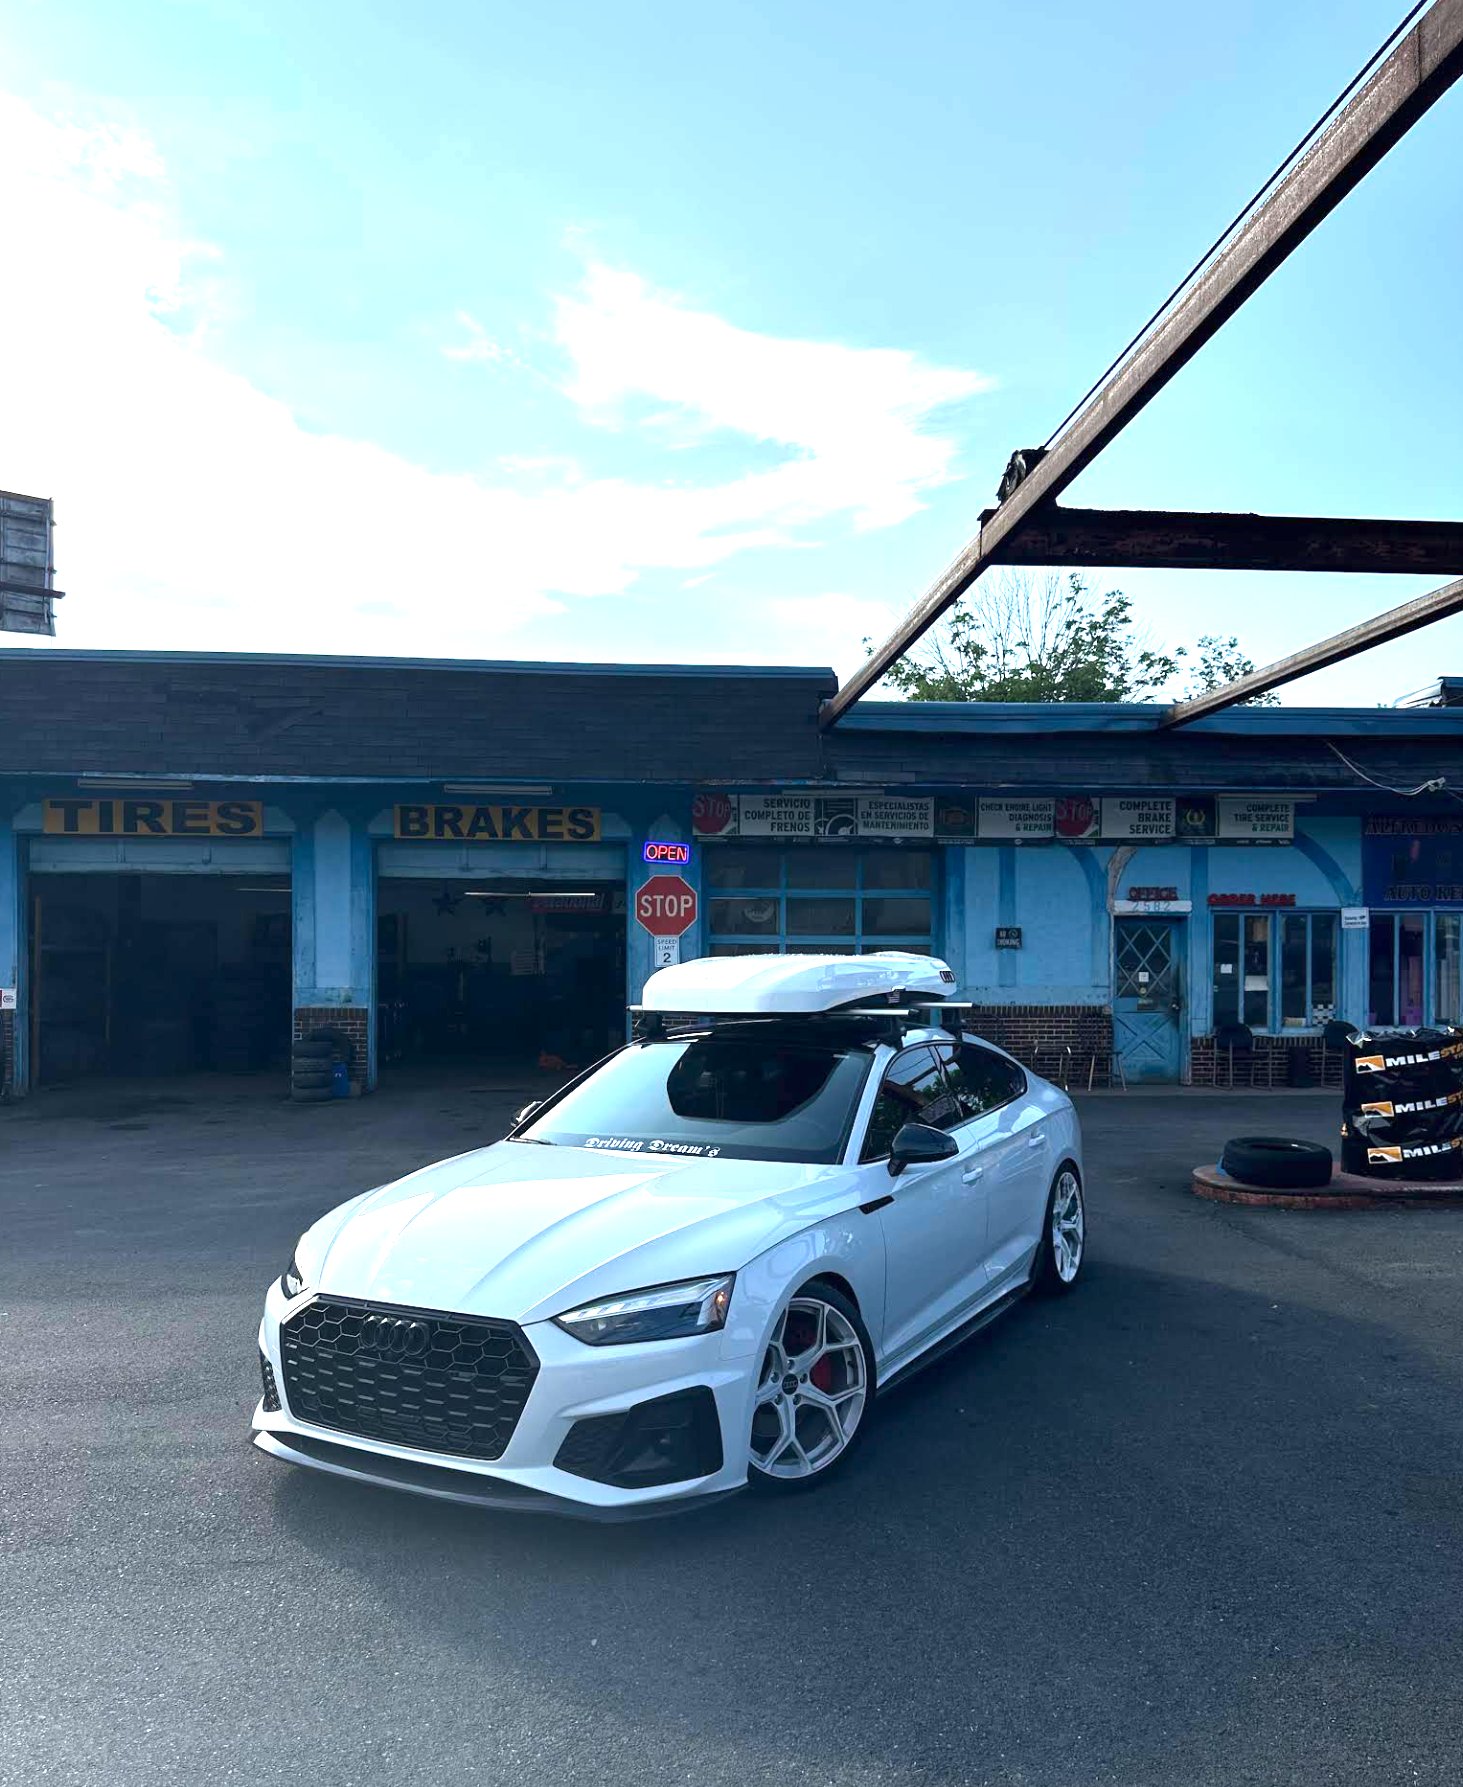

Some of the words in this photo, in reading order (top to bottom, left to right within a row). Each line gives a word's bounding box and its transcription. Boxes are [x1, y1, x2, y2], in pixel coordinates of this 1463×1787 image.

[693, 797, 731, 817] STOP
[763, 798, 811, 808] SERVICIO
[868, 801, 930, 811] ESPECIALISTAS
[980, 803, 1003, 812] CHECK
[1005, 803, 1030, 812] ENGINE
[1032, 803, 1052, 812] LIGHT
[1119, 801, 1172, 811] COMPLETE
[1246, 803, 1290, 813] COMPLETE
[50, 801, 257, 834] TIRES
[744, 810, 795, 820] COMPLETO
[798, 811, 811, 820] DE
[860, 811, 872, 820] EN
[874, 811, 917, 821] SERVICIOS
[919, 812, 929, 820] DE
[1009, 813, 1052, 822] DIAGNOSIS
[1137, 812, 1172, 822] BRAKE
[1233, 813, 1253, 823] TIRE
[1255, 813, 1290, 823] SERVICE
[400, 806, 596, 839] BRAKES
[770, 822, 811, 832] FRENOS
[863, 821, 929, 831] MANTENIMIENTO
[1023, 823, 1052, 832] REPAIR
[1259, 823, 1290, 832] REPAIR
[1128, 824, 1172, 834] SERVICE
[646, 844, 687, 861] OPEN
[1128, 887, 1178, 900] OFFICE
[640, 894, 693, 917] STOP
[1132, 901, 1170, 911] 2582
[663, 952, 671, 963] 2
[584, 1137, 644, 1152] Driving
[648, 1139, 721, 1157] Dream's
